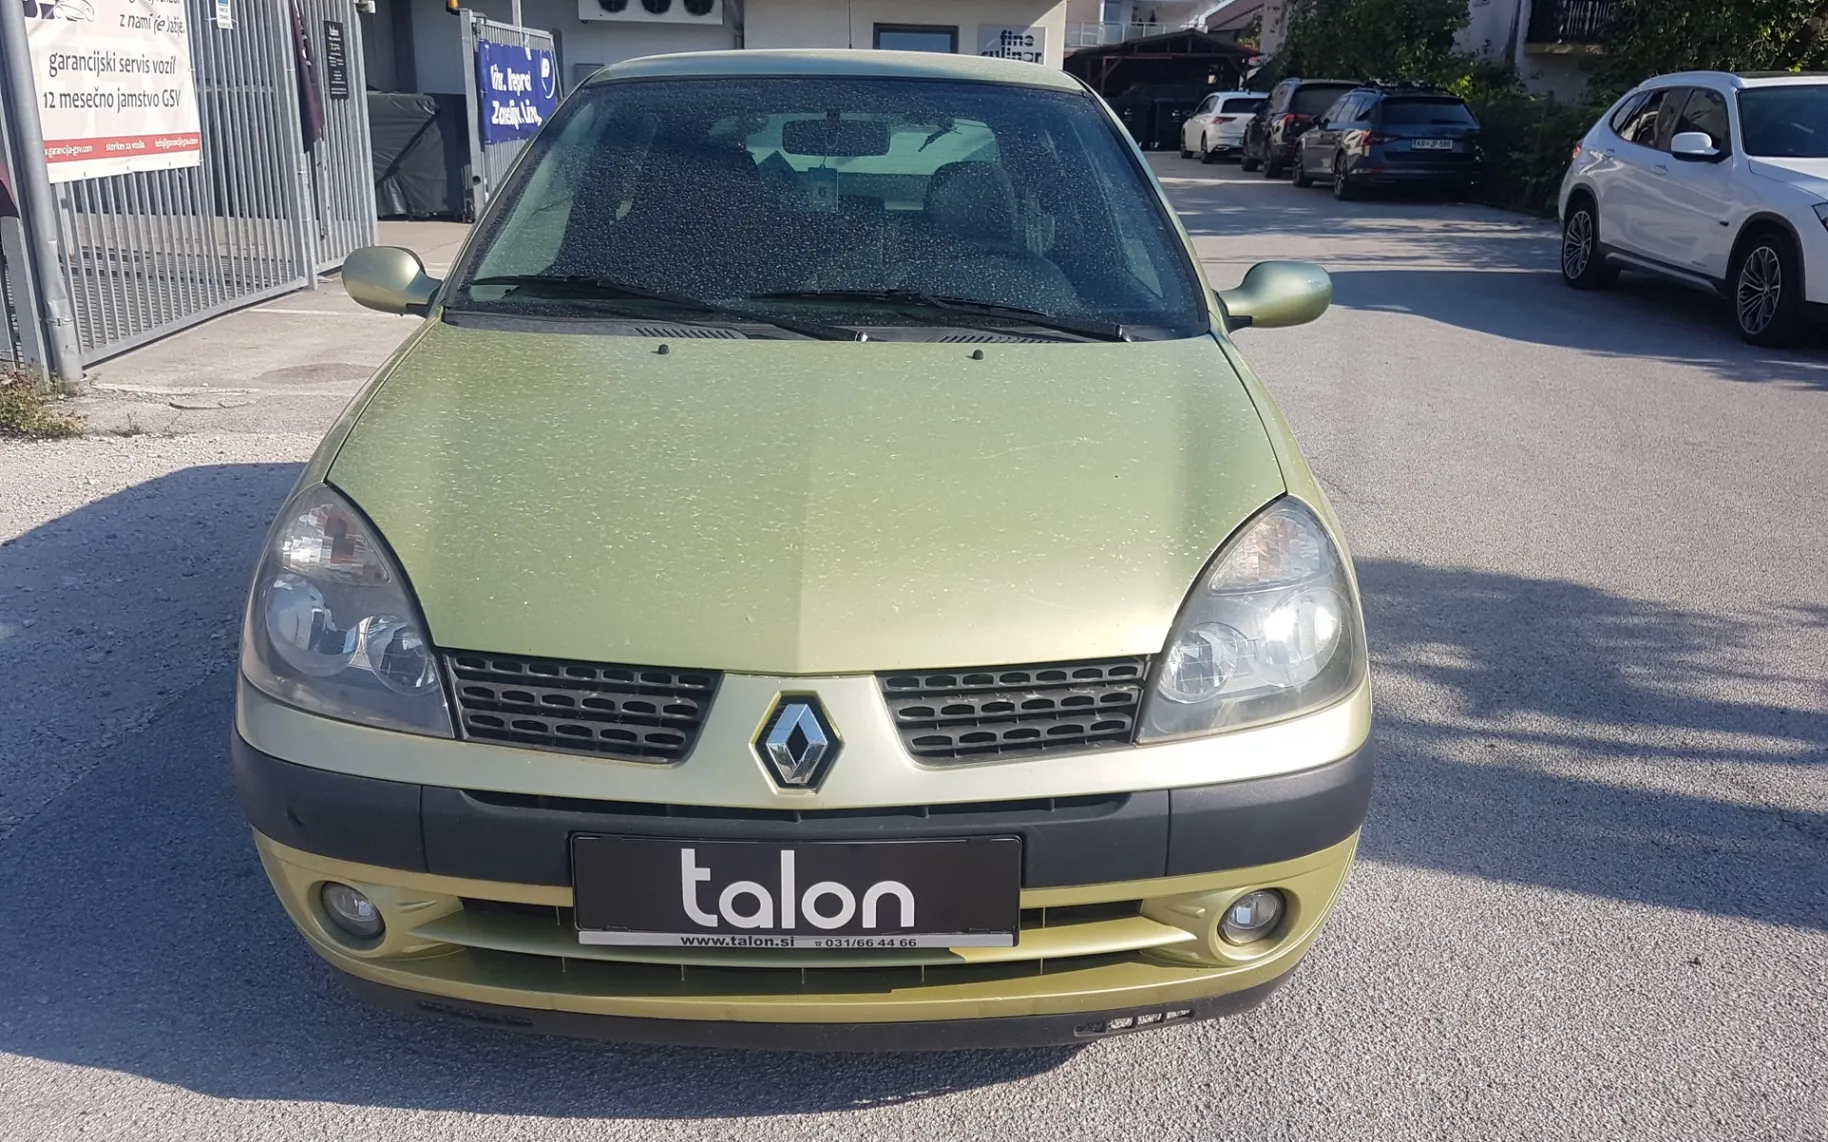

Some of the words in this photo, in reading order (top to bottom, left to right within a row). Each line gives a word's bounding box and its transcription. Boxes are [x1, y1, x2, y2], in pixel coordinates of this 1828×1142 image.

[119, 14, 125, 27] z
[127, 13, 153, 30] nami
[1000, 30, 1034, 46] fine
[48, 50, 116, 78] garancijski
[119, 54, 150, 73] servis
[152, 55, 176, 74] vozil
[43, 91, 55, 108] 12
[59, 86, 114, 108] mesečno
[117, 87, 159, 113] jamstvo
[161, 89, 181, 107] GSV
[681, 848, 915, 929] talon
[680, 935, 795, 947] www.talon.si
[825, 938, 874, 947] 031/66
[877, 938, 896, 947] 44
[899, 938, 917, 947] 66
